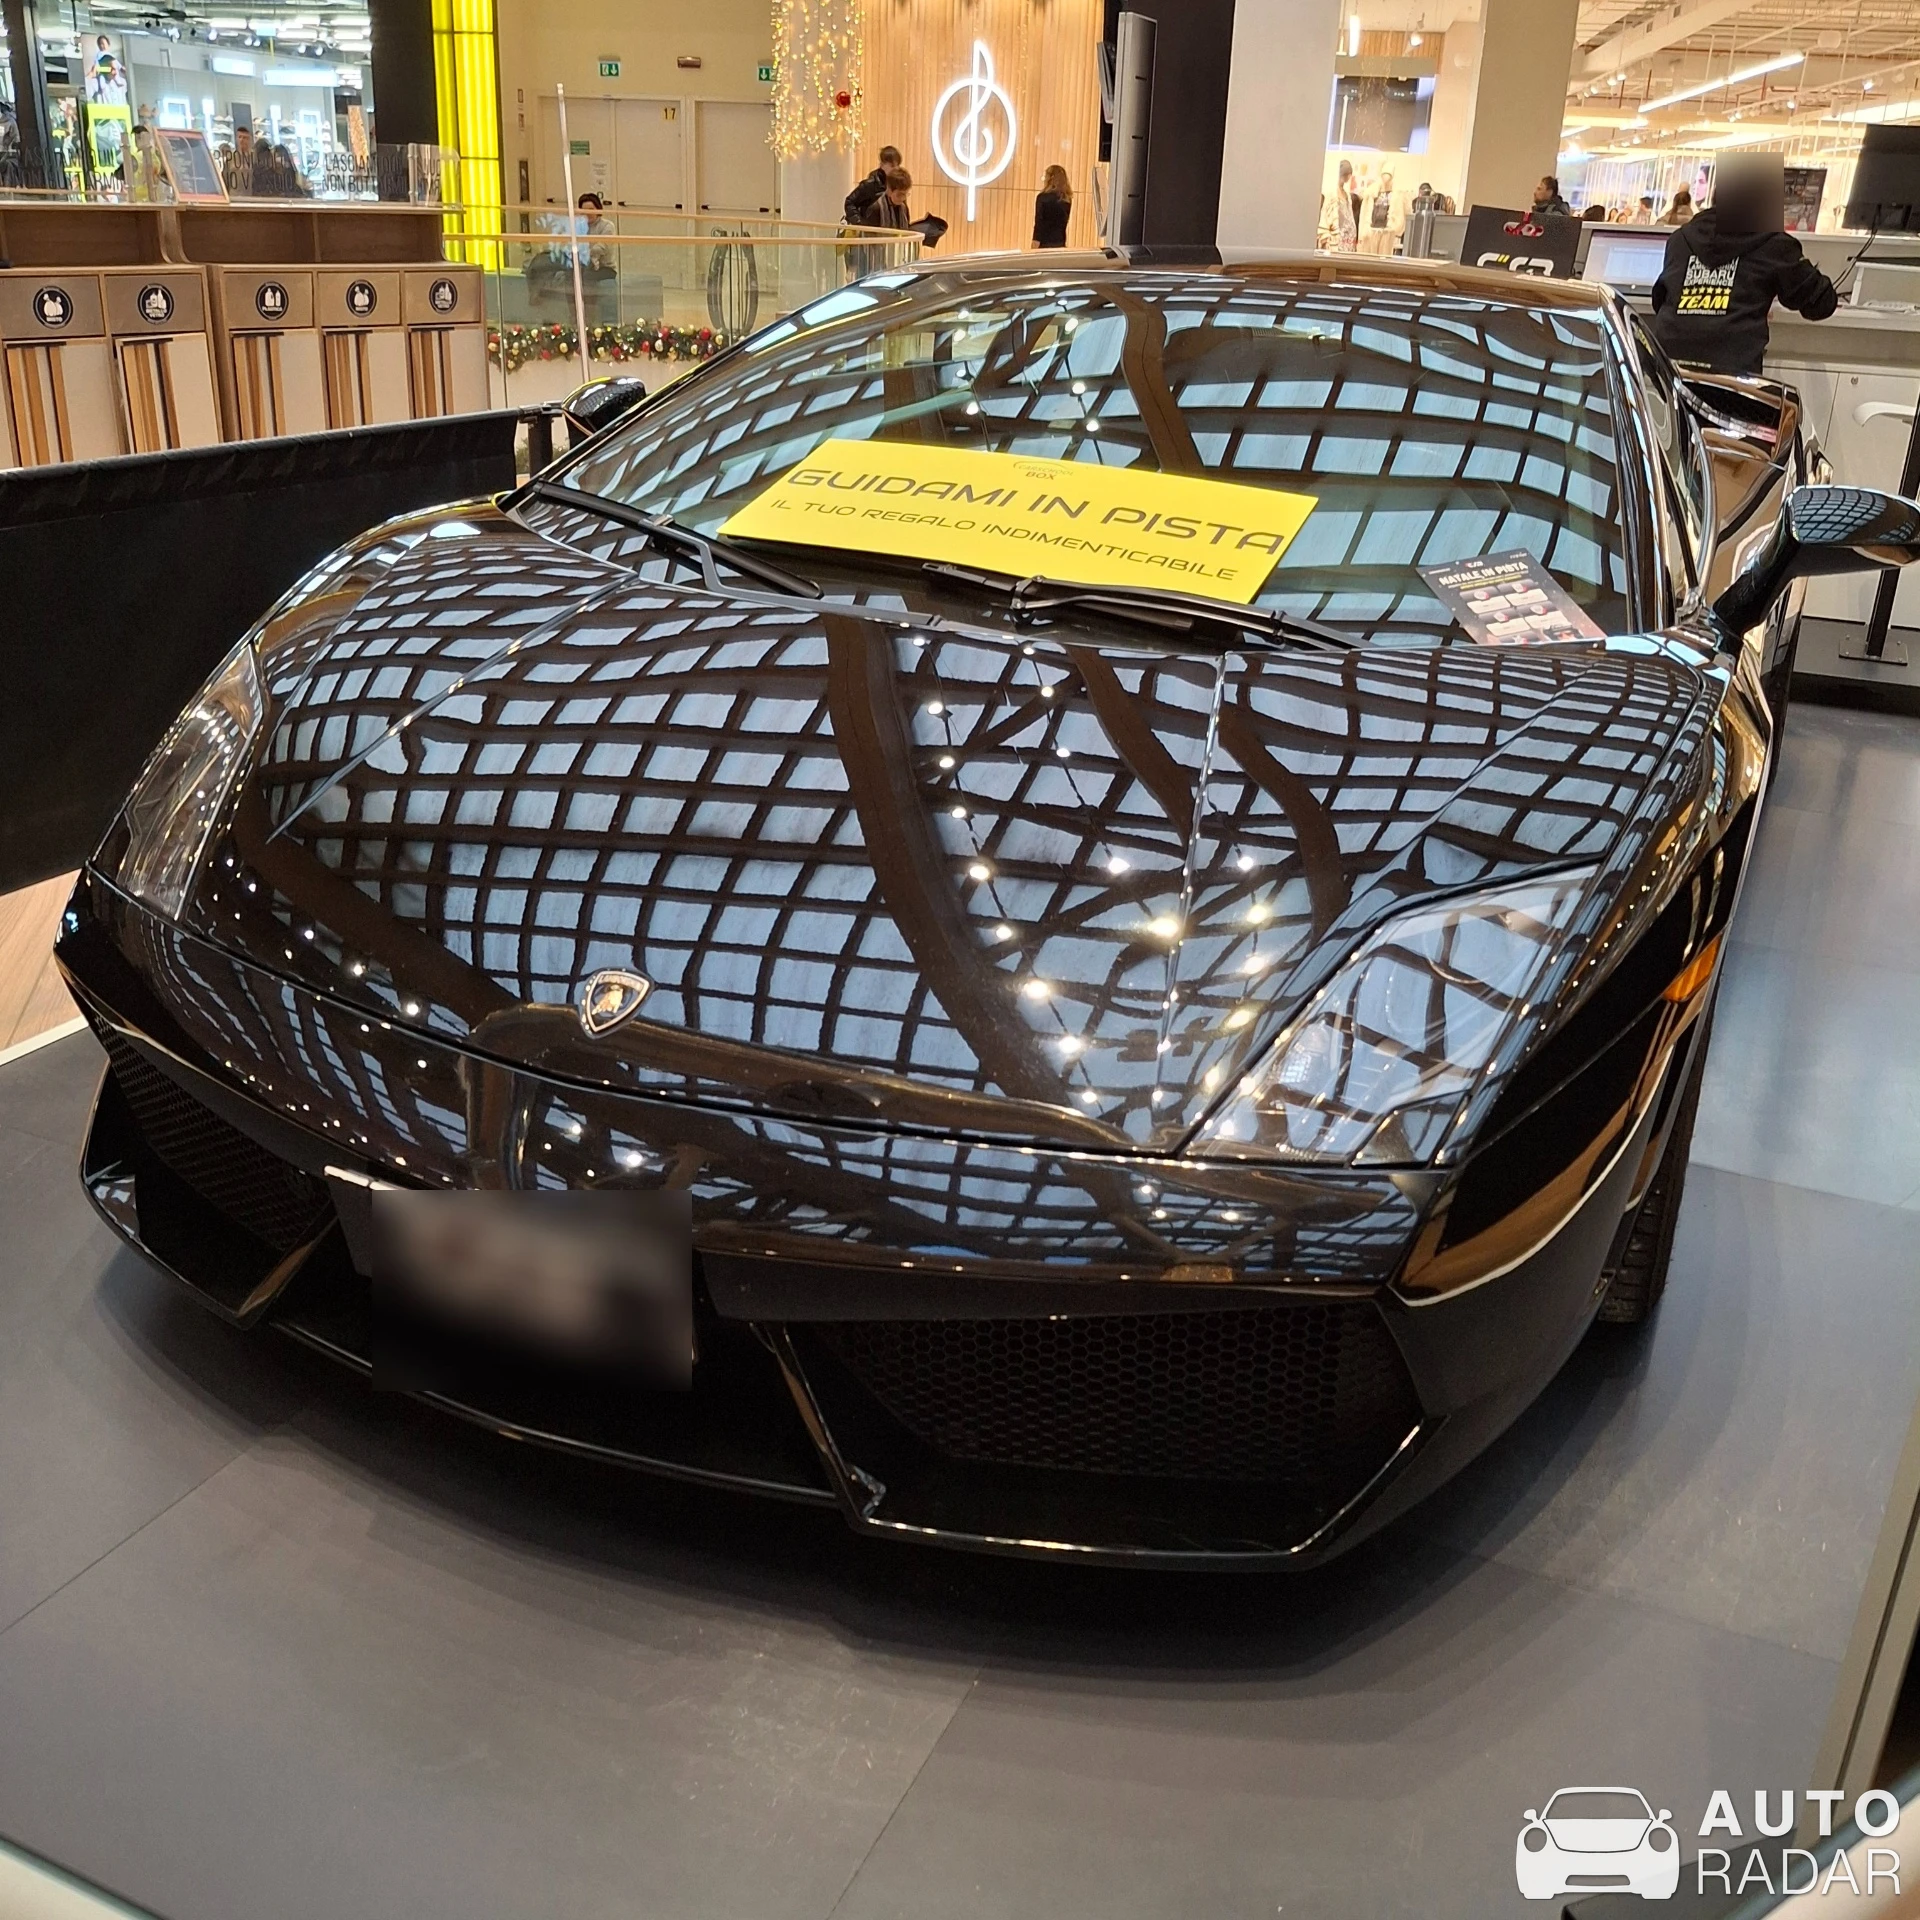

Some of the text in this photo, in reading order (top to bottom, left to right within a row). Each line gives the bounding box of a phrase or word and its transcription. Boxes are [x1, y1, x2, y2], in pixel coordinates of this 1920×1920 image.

[663, 107, 677, 121] 17
[1686, 269, 1736, 280] SUBARU
[1683, 278, 1734, 287] EXPERIENCE
[1678, 295, 1730, 309] TEAM
[1025, 471, 1057, 481] BOX
[787, 468, 1285, 555] GUIDAMI IN PISTA
[770, 499, 1239, 581] IL TUO REGALO INDIMENTICABILE
[1439, 570, 1483, 586] NATALE
[1481, 568, 1495, 578] IN
[1495, 562, 1529, 576] PISTA
